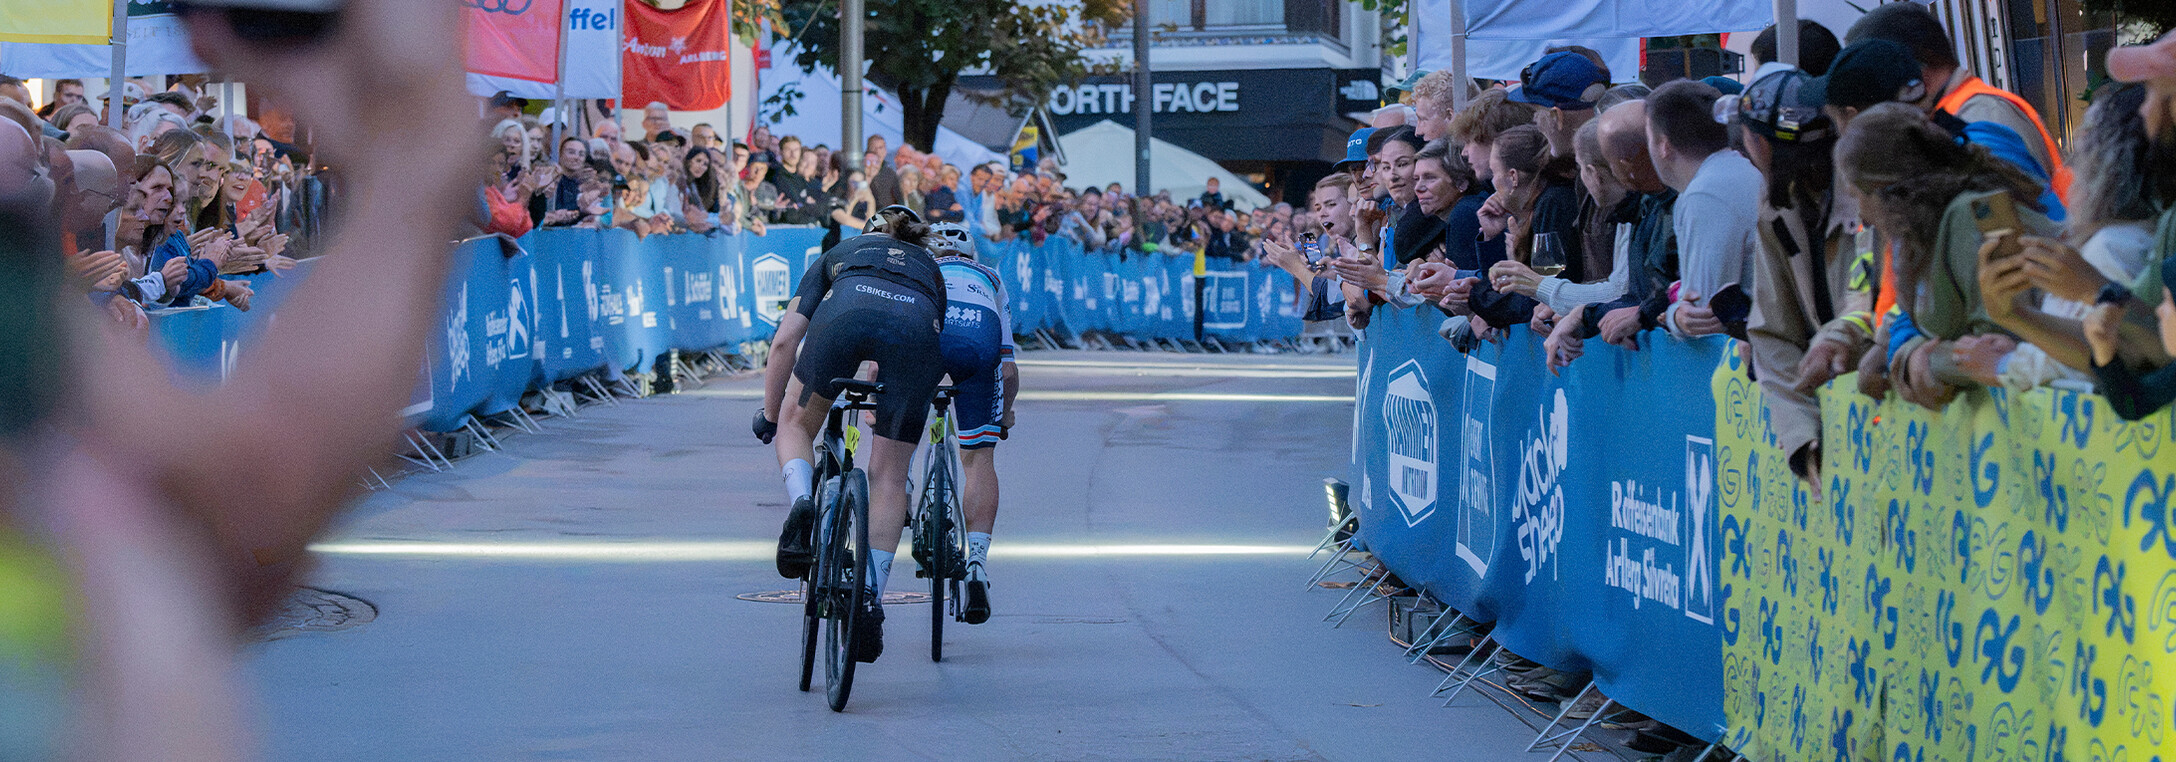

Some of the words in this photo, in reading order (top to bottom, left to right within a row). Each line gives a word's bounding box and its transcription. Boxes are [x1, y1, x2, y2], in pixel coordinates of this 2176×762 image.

[679, 50, 727, 65] ARLBERG
[1049, 83, 1136, 116] ORTH
[1153, 81, 1239, 114] FACE
[855, 284, 915, 305] CSBIKES.COM
